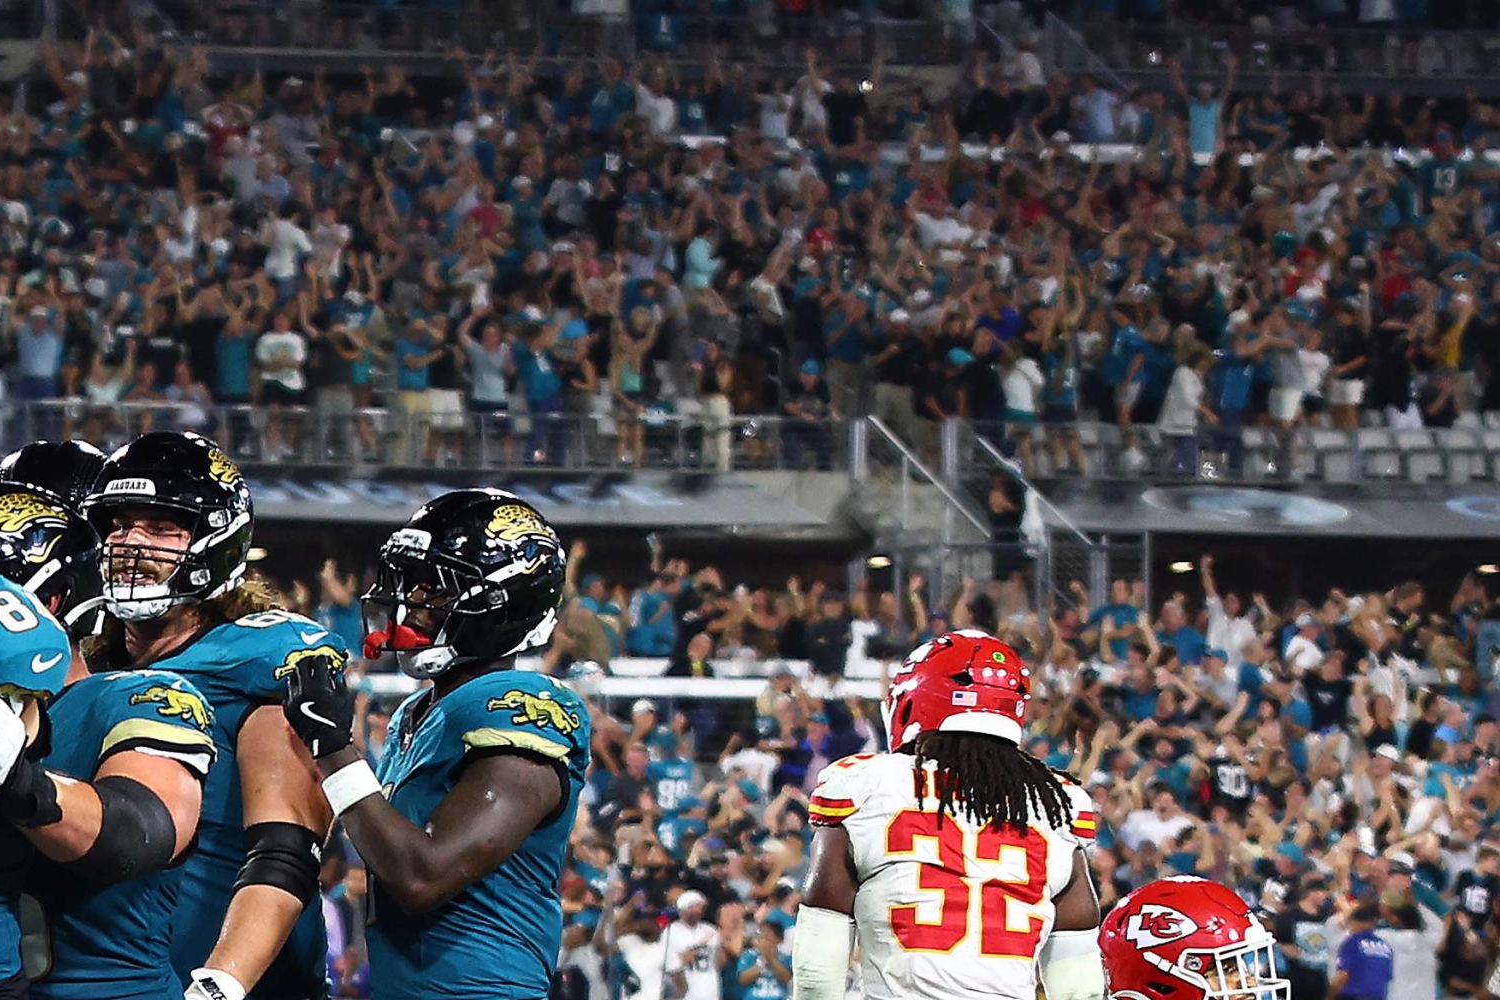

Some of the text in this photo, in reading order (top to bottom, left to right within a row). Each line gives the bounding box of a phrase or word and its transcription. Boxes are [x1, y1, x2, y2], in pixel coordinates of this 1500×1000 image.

[109, 480, 148, 491] JAGUARS
[884, 809, 1051, 960] 32
[1139, 911, 1185, 939] KC
